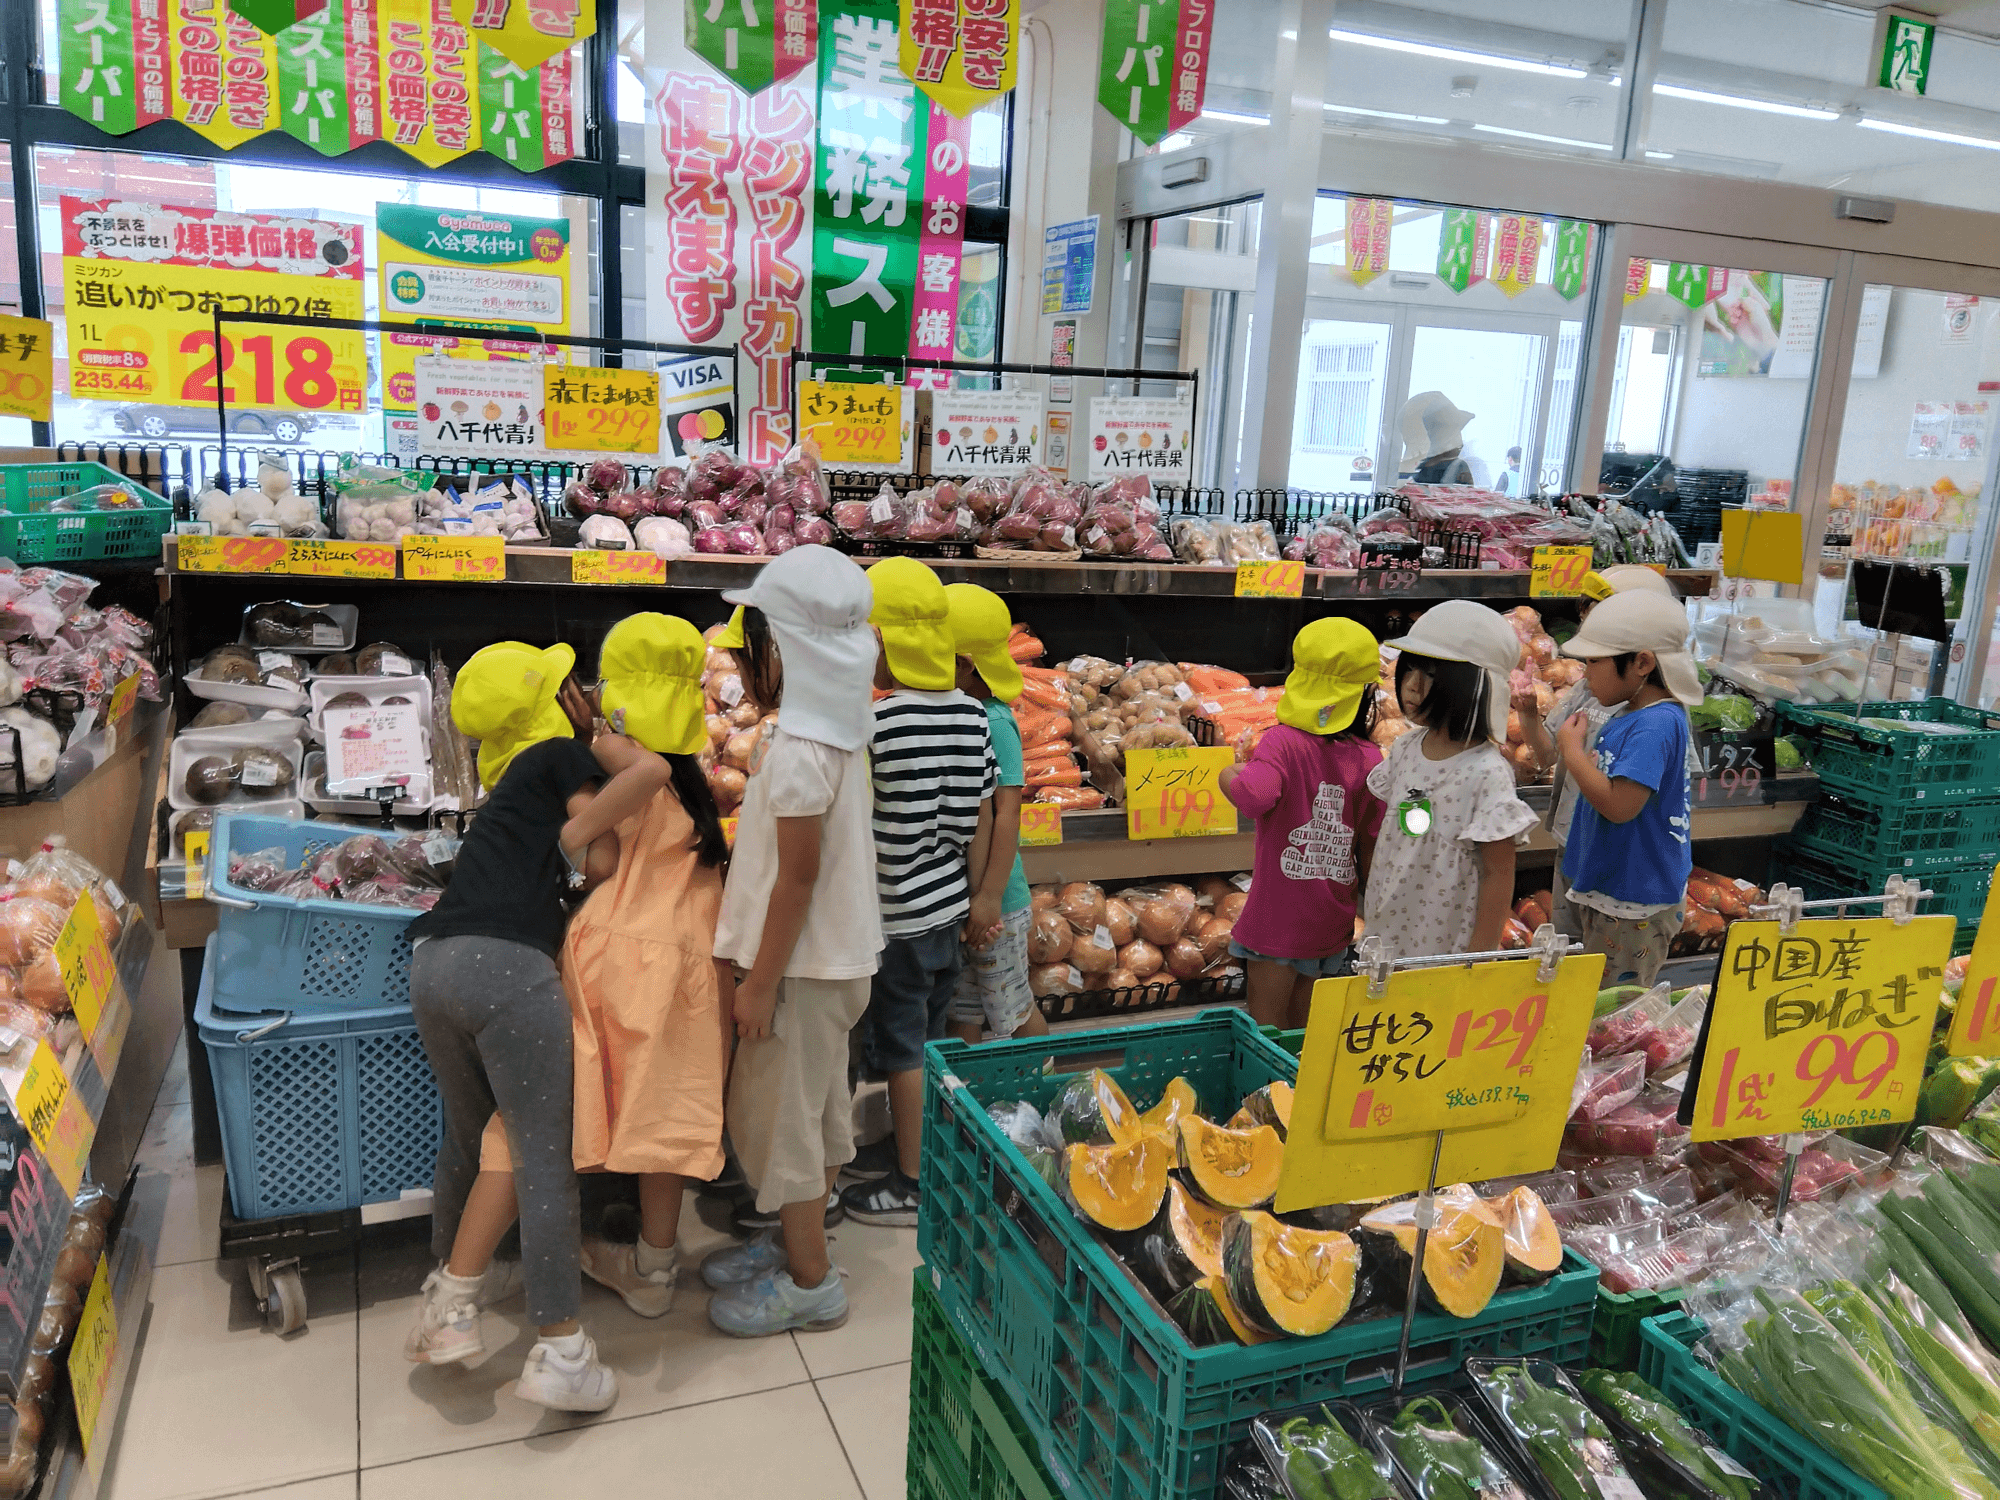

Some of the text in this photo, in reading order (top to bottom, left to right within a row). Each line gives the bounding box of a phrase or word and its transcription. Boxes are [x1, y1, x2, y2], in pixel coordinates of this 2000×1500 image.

[1115, 0, 1164, 124] ーパー
[290, 12, 336, 143] スーパー
[661, 78, 736, 341] 使えます
[87, 216, 146, 232] 不景気を
[438, 215, 513, 233] Gyomuca
[89, 234, 168, 249] ぶっとばせ!
[174, 221, 318, 260] 爆弾価格
[425, 231, 525, 257] 入会受付中!
[540, 246, 558, 258] 0円
[74, 264, 123, 278] ミツカン
[75, 279, 333, 319] 追いがつおつゆ2倍
[79, 323, 103, 342] 1L
[82, 352, 145, 367] 消費税率8%
[671, 363, 723, 389] VISA
[548, 378, 660, 407] 赤たまねぎ
[807, 391, 894, 417] さつまいも
[946, 445, 1033, 464] 八千代青果
[1103, 449, 1183, 468] 八千代青果
[405, 547, 472, 561] プチにんにく
[1702, 744, 1764, 773] レタス
[1135, 764, 1211, 792] メークイン
[1159, 787, 1215, 828] 199
[1284, 861, 1303, 873] GAP
[1732, 927, 1871, 992] 中国産
[1763, 964, 1943, 1041] 白ねぎ
[1341, 1011, 1435, 1054] 甘とう
[1358, 1052, 1448, 1085] がらし
